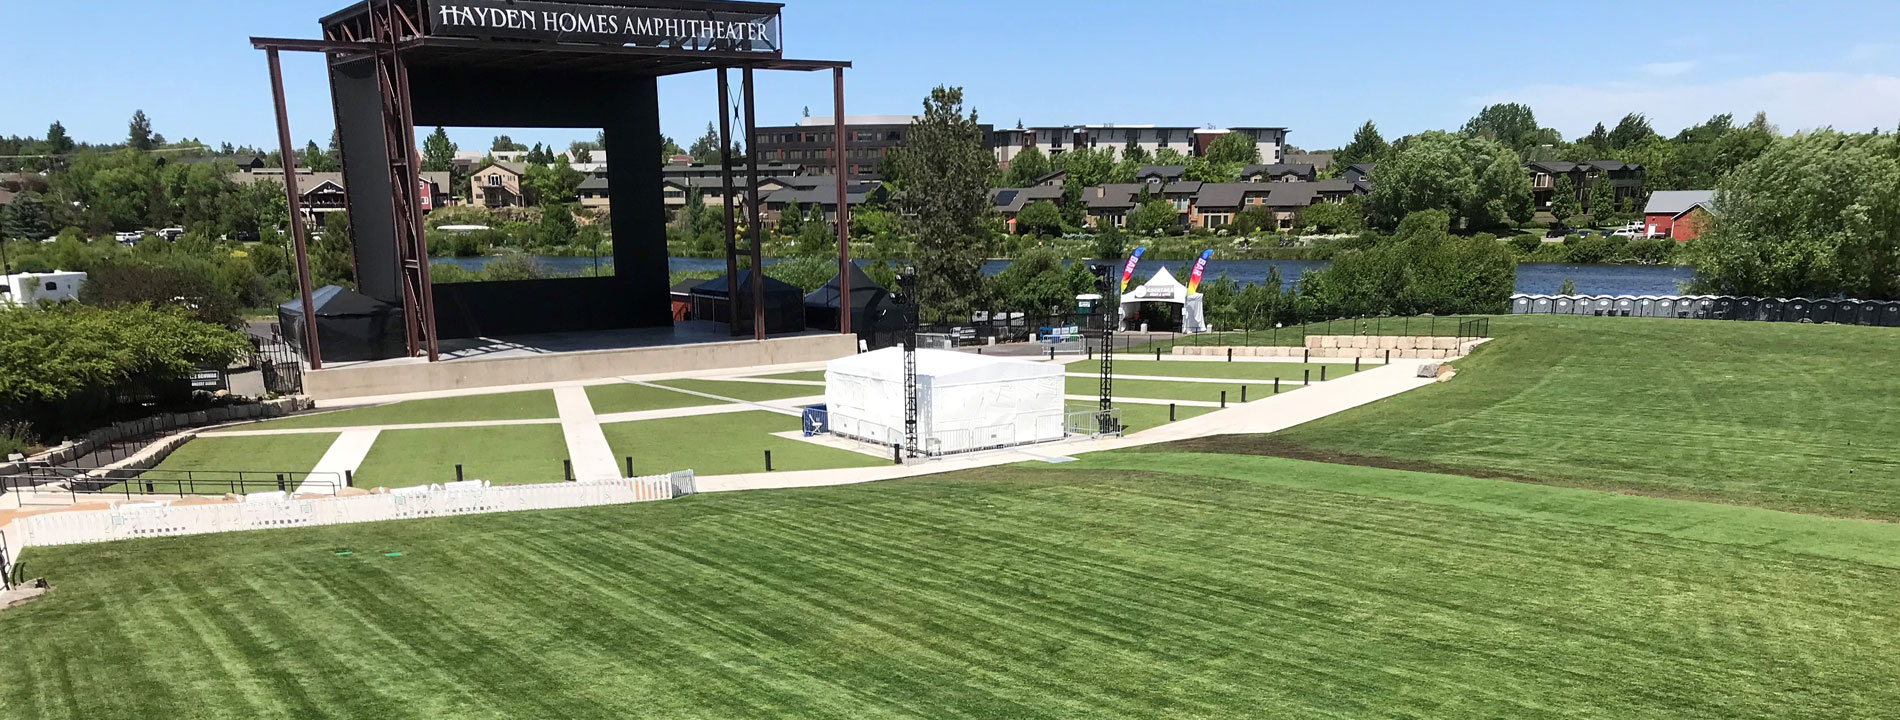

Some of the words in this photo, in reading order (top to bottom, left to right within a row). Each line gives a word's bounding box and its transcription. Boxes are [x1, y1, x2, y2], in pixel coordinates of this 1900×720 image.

[439, 5, 537, 31] HAYDEN
[543, 11, 619, 35] HOMES
[622, 15, 770, 41] AMPHITHEATER
[1125, 255, 1139, 274] BAR
[1194, 257, 1207, 277] BAR
